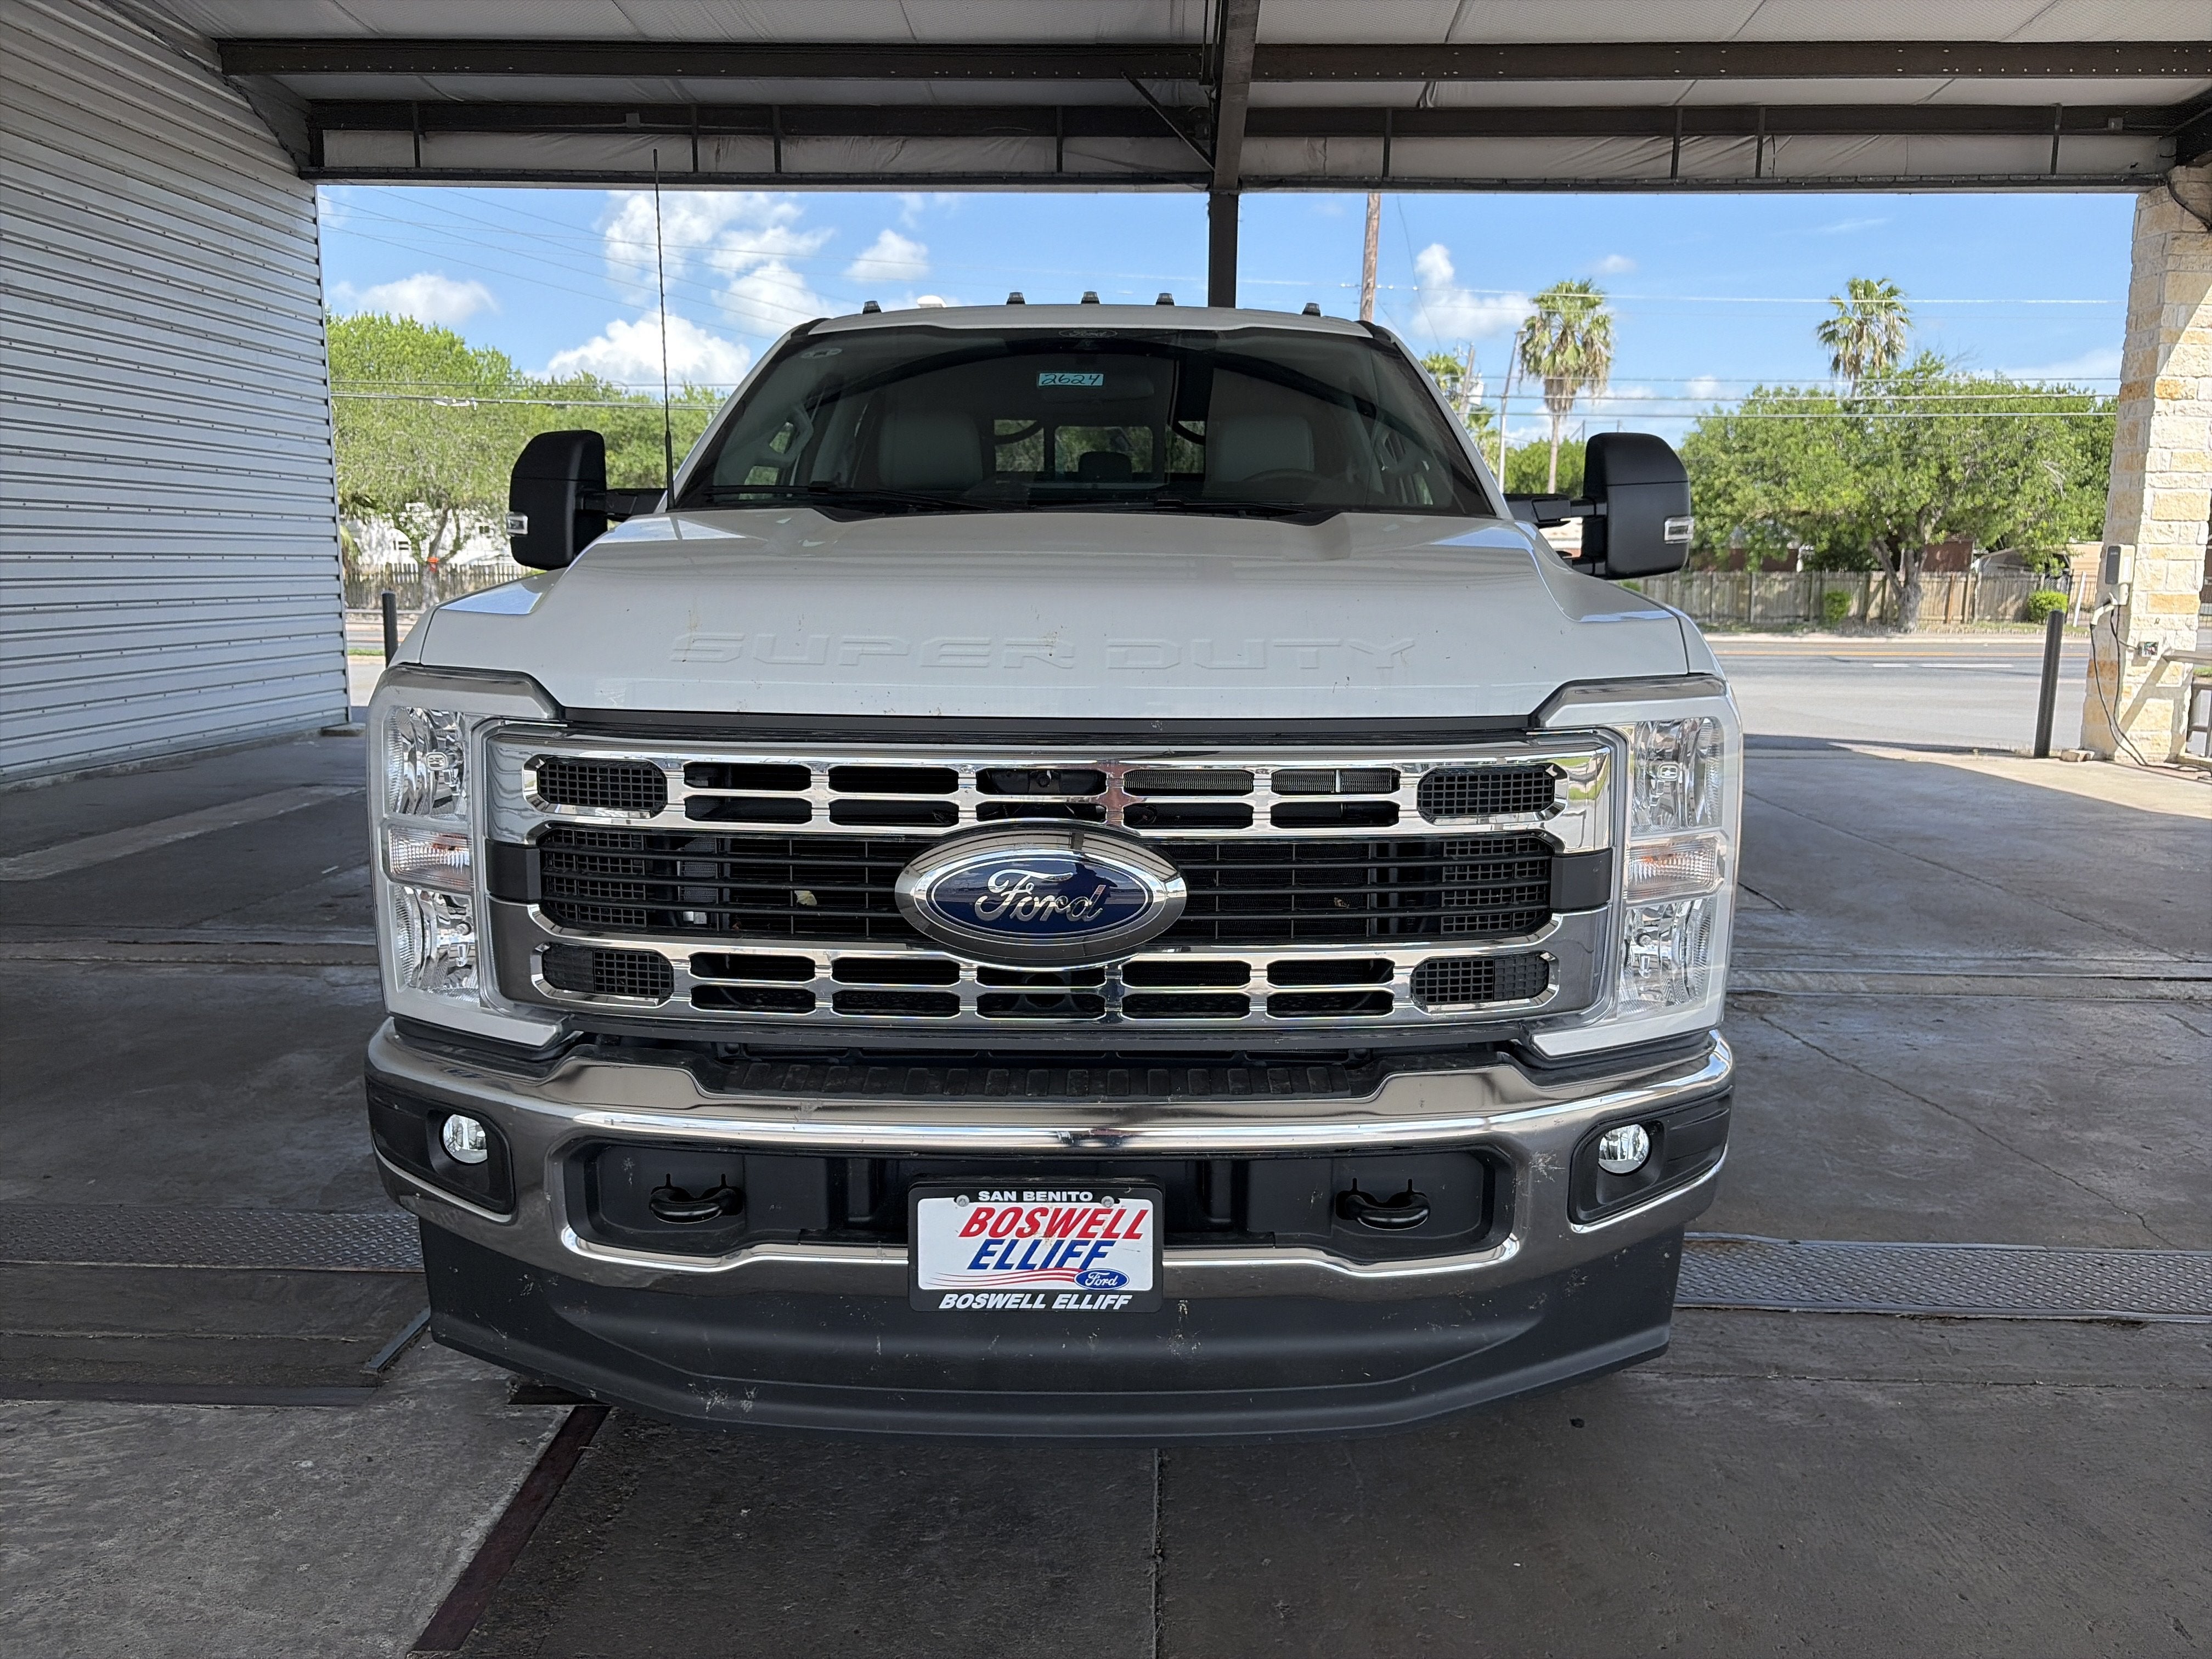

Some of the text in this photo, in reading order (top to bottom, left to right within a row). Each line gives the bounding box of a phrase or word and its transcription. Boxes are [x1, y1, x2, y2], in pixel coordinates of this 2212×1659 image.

[1042, 374, 1100, 385] 2624
[670, 633, 1415, 669] SUPER DUTY
[974, 869, 1106, 922] Ford
[978, 1191, 1093, 1201] SAN BENITO
[958, 1207, 1149, 1239] BOSWELL
[967, 1239, 1119, 1270] ELLIFF
[1085, 1272, 1118, 1286] Ford
[939, 1294, 1133, 1310] BOSWELL ELLIFF
